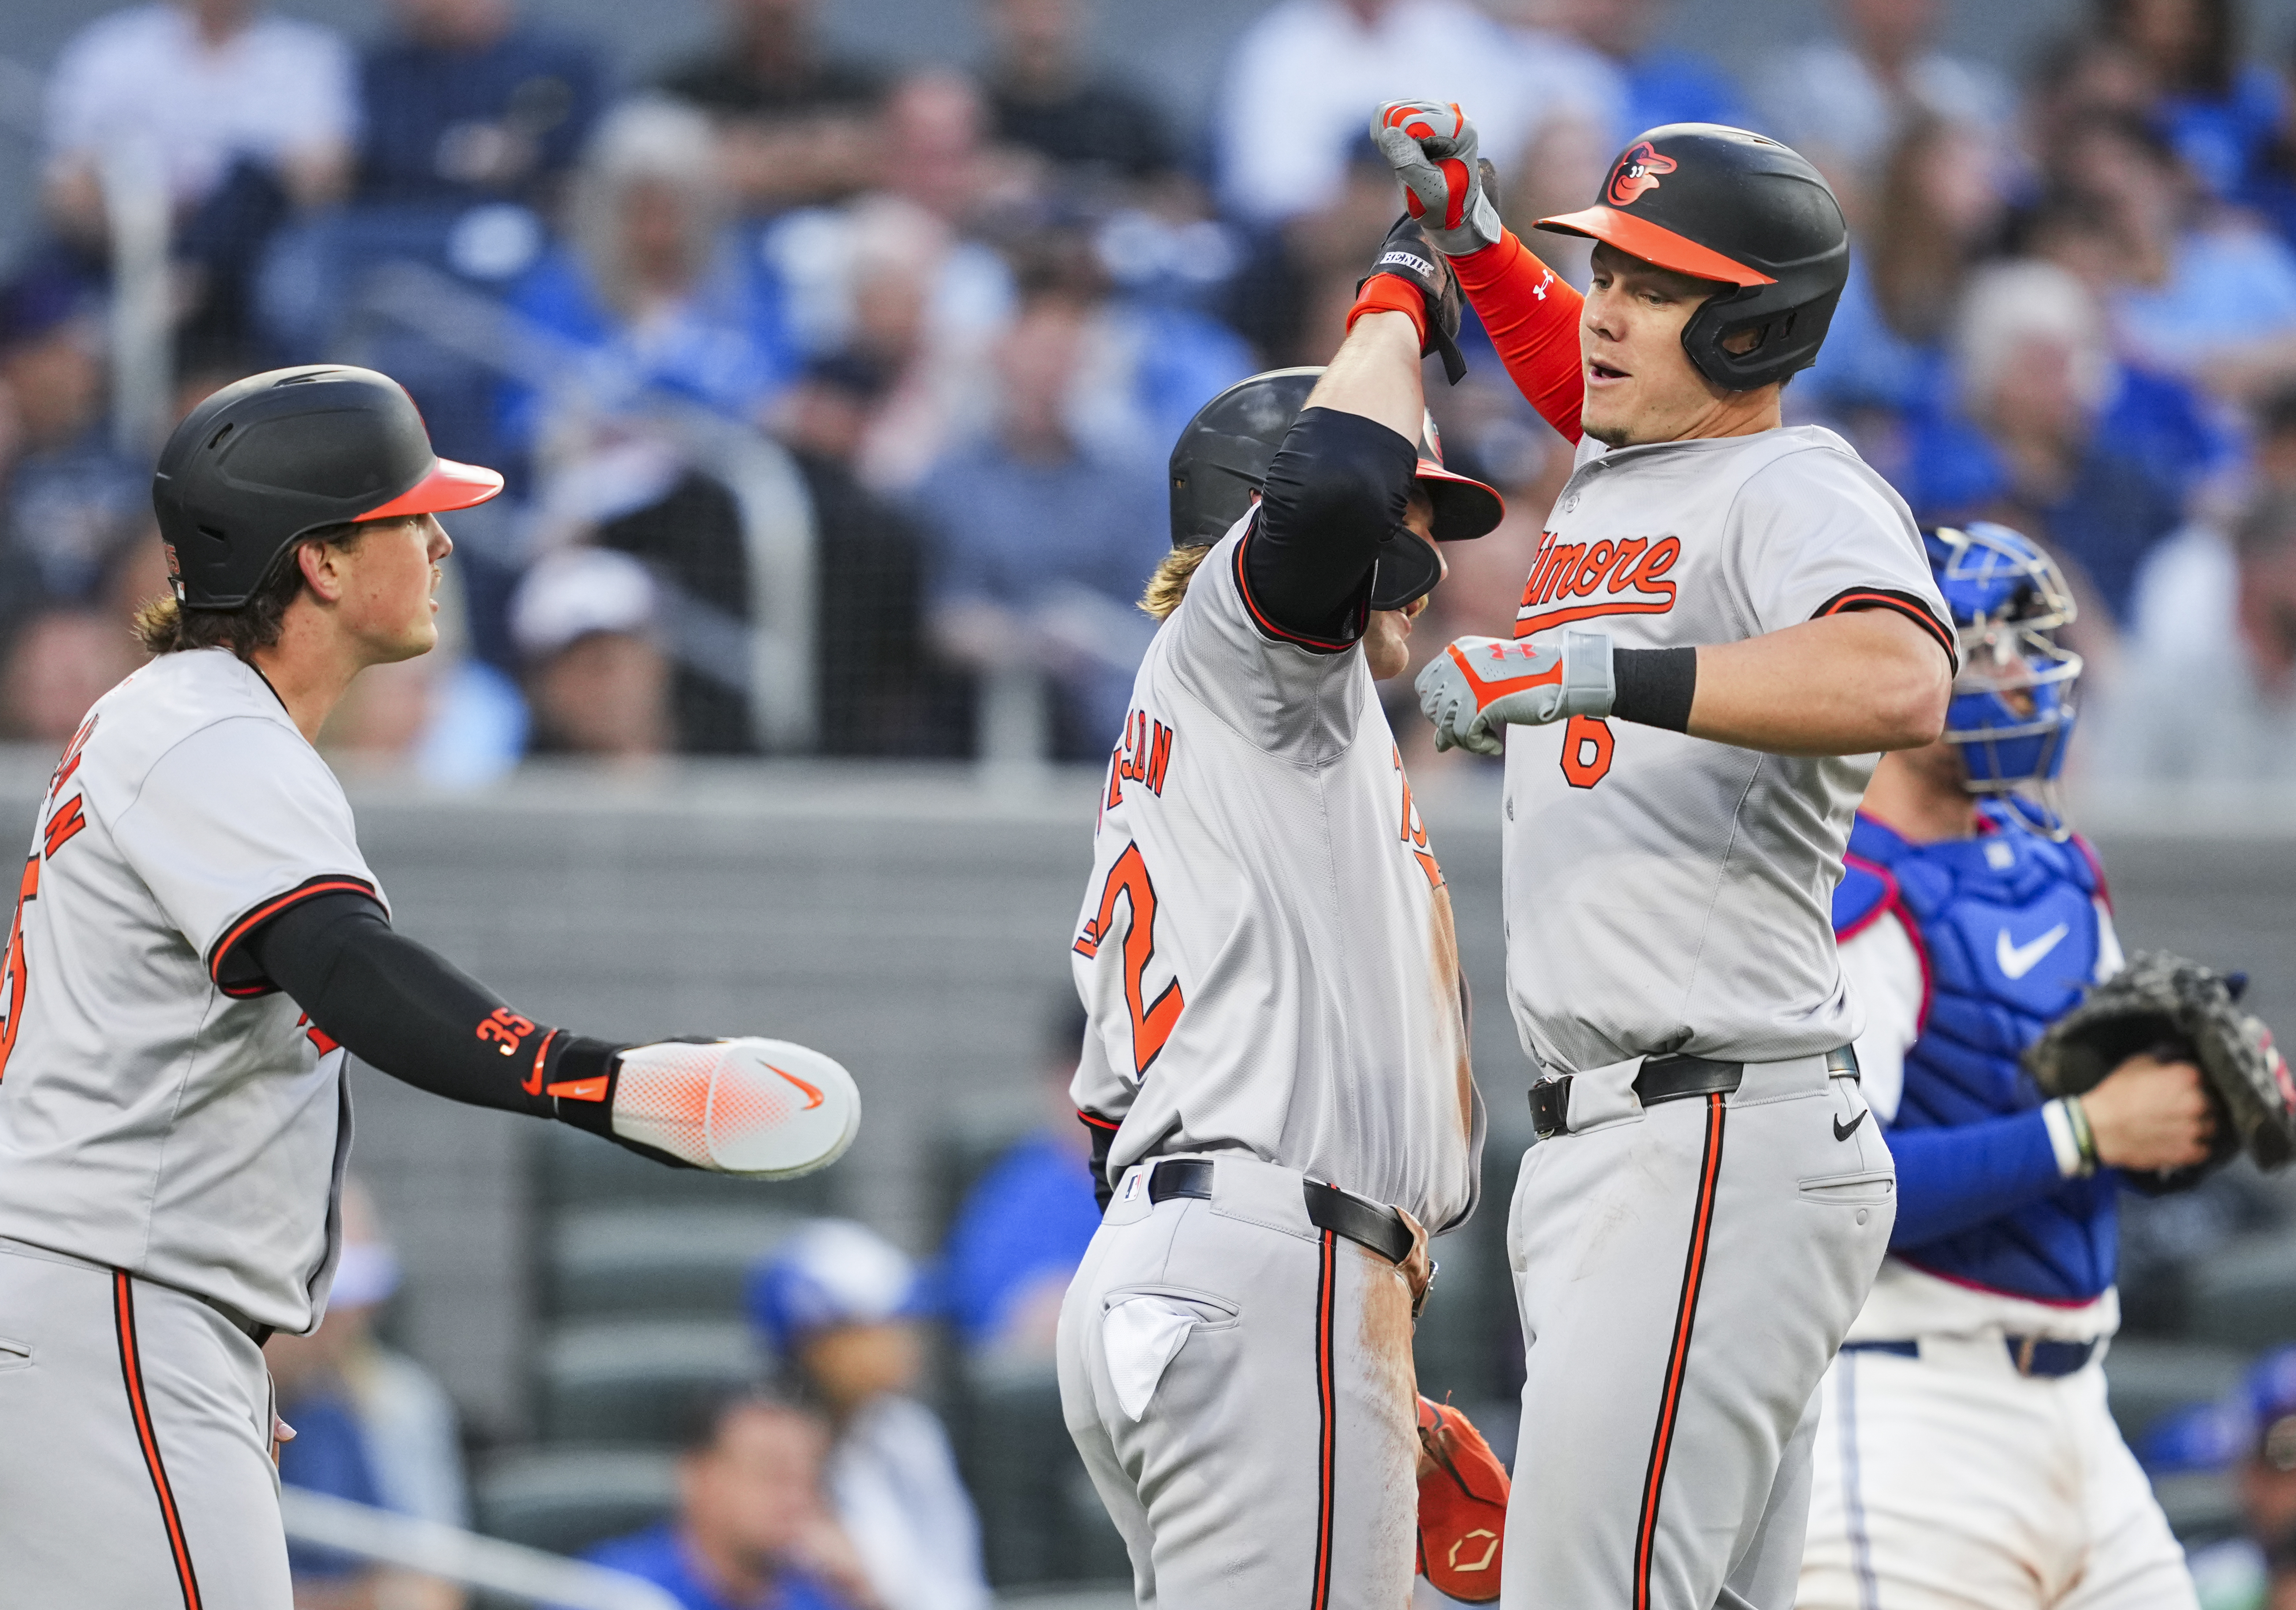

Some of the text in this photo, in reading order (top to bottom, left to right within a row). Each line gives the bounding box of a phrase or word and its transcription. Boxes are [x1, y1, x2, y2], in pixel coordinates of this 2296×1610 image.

[1380, 252, 1434, 277] BENIK
[1560, 714, 1615, 789] 6
[1073, 838, 1185, 1082] 2
[476, 1006, 536, 1056] 35
